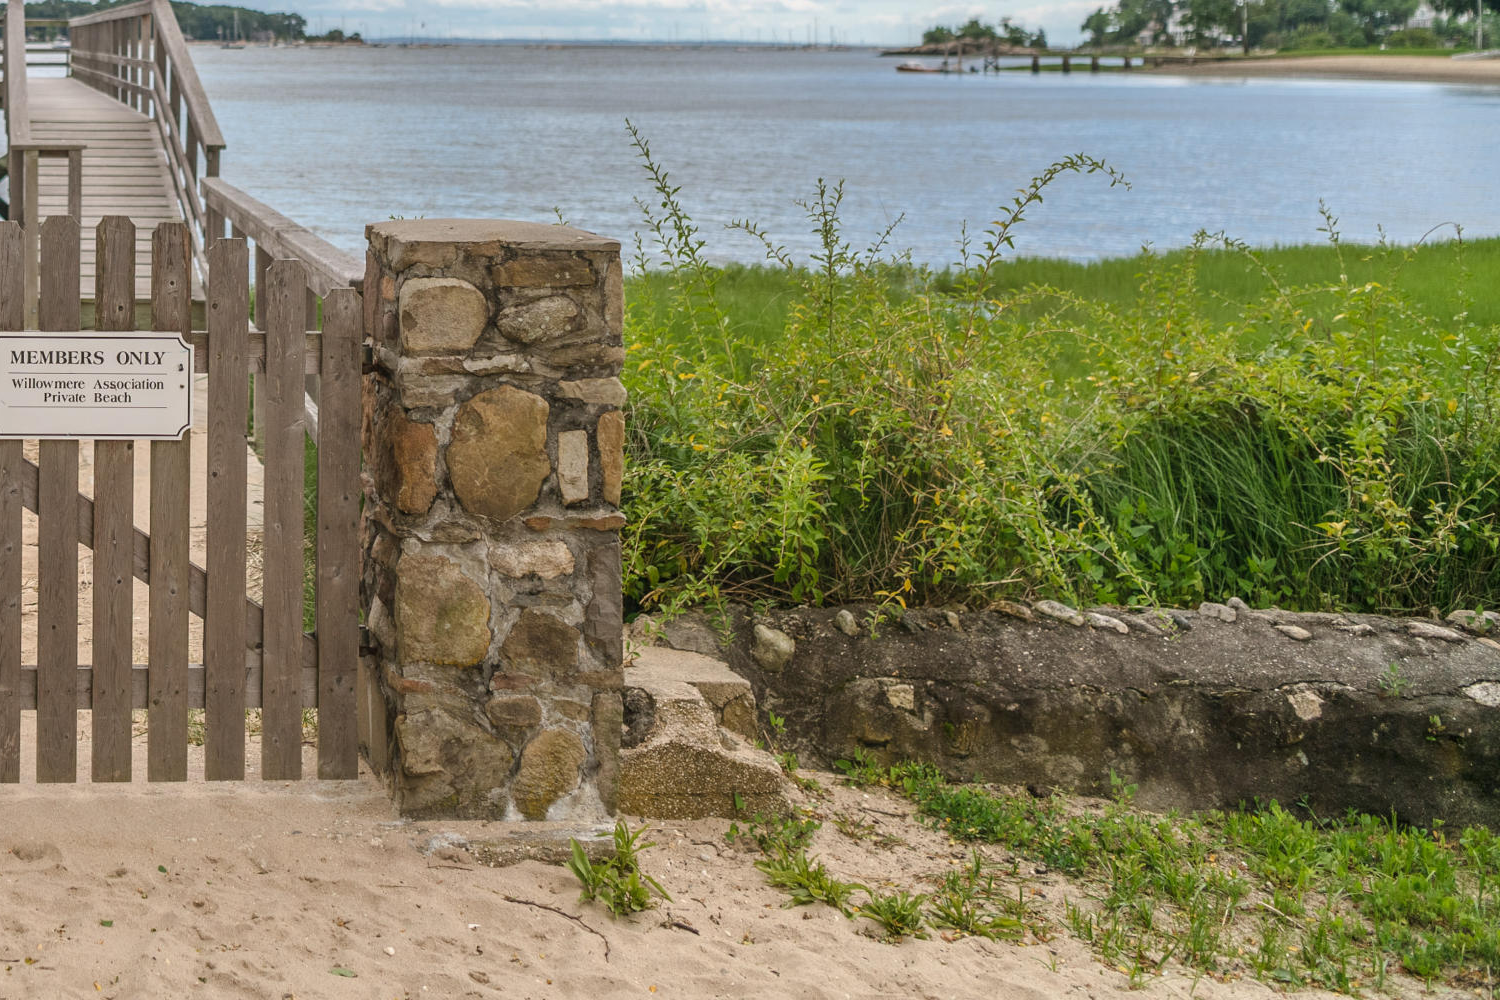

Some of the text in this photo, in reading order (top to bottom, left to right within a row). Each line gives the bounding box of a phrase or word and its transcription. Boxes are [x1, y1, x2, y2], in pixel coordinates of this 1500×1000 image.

[10, 350, 166, 365] MEMBERS ONLY
[12, 378, 164, 390] Willowmere Association
[43, 392, 132, 403] Private Beach
